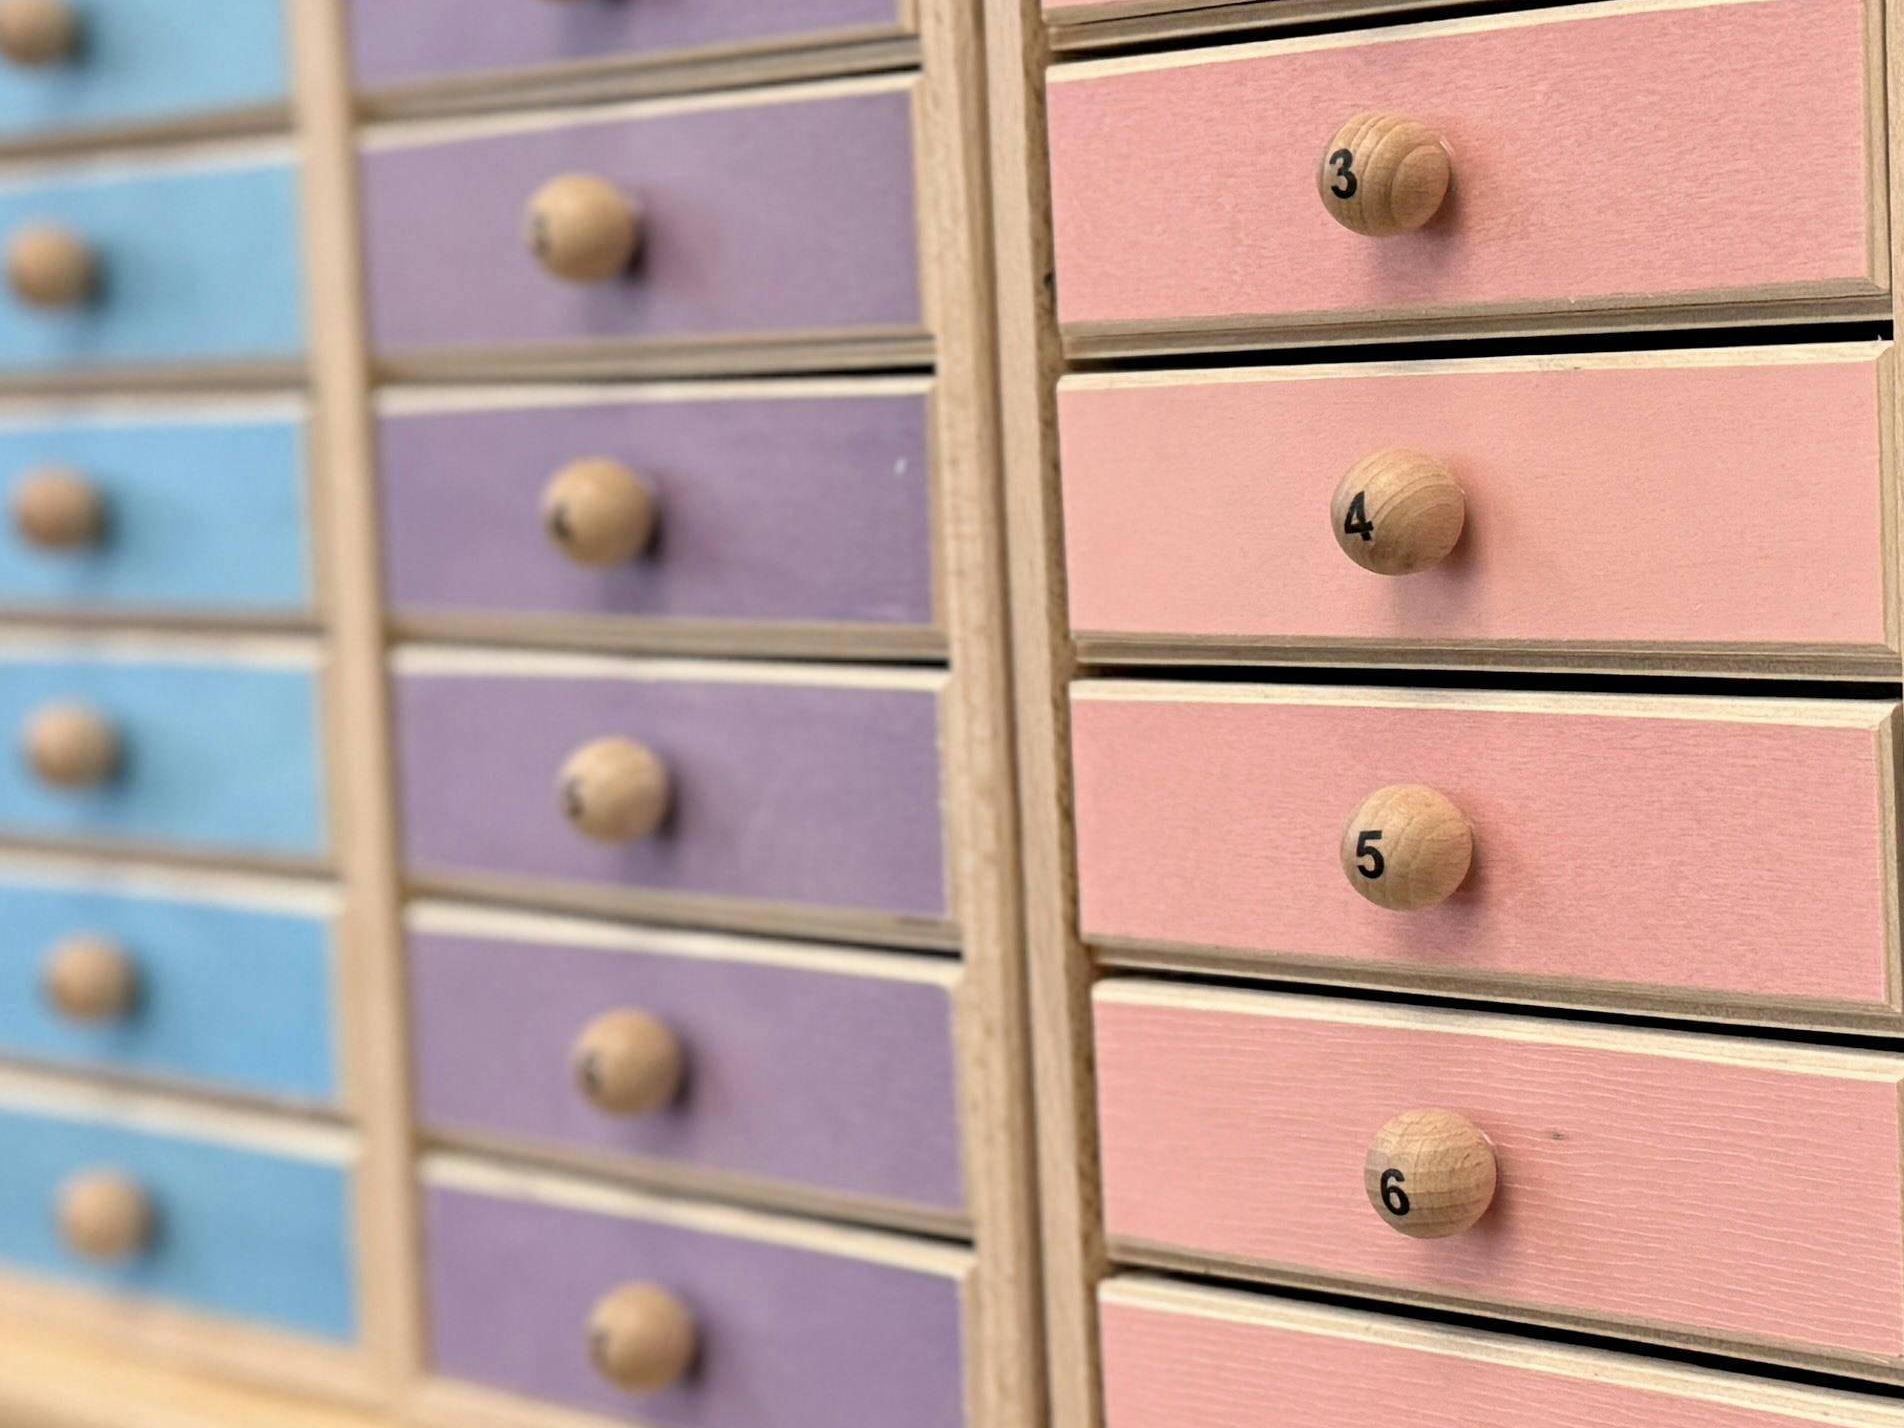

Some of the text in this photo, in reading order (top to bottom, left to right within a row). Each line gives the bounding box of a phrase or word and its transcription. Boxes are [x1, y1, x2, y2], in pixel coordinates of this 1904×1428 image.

[1329, 149, 1358, 200] 3
[1343, 491, 1374, 542] 4
[1356, 830, 1385, 880] 5
[1380, 1168, 1413, 1217] 6
